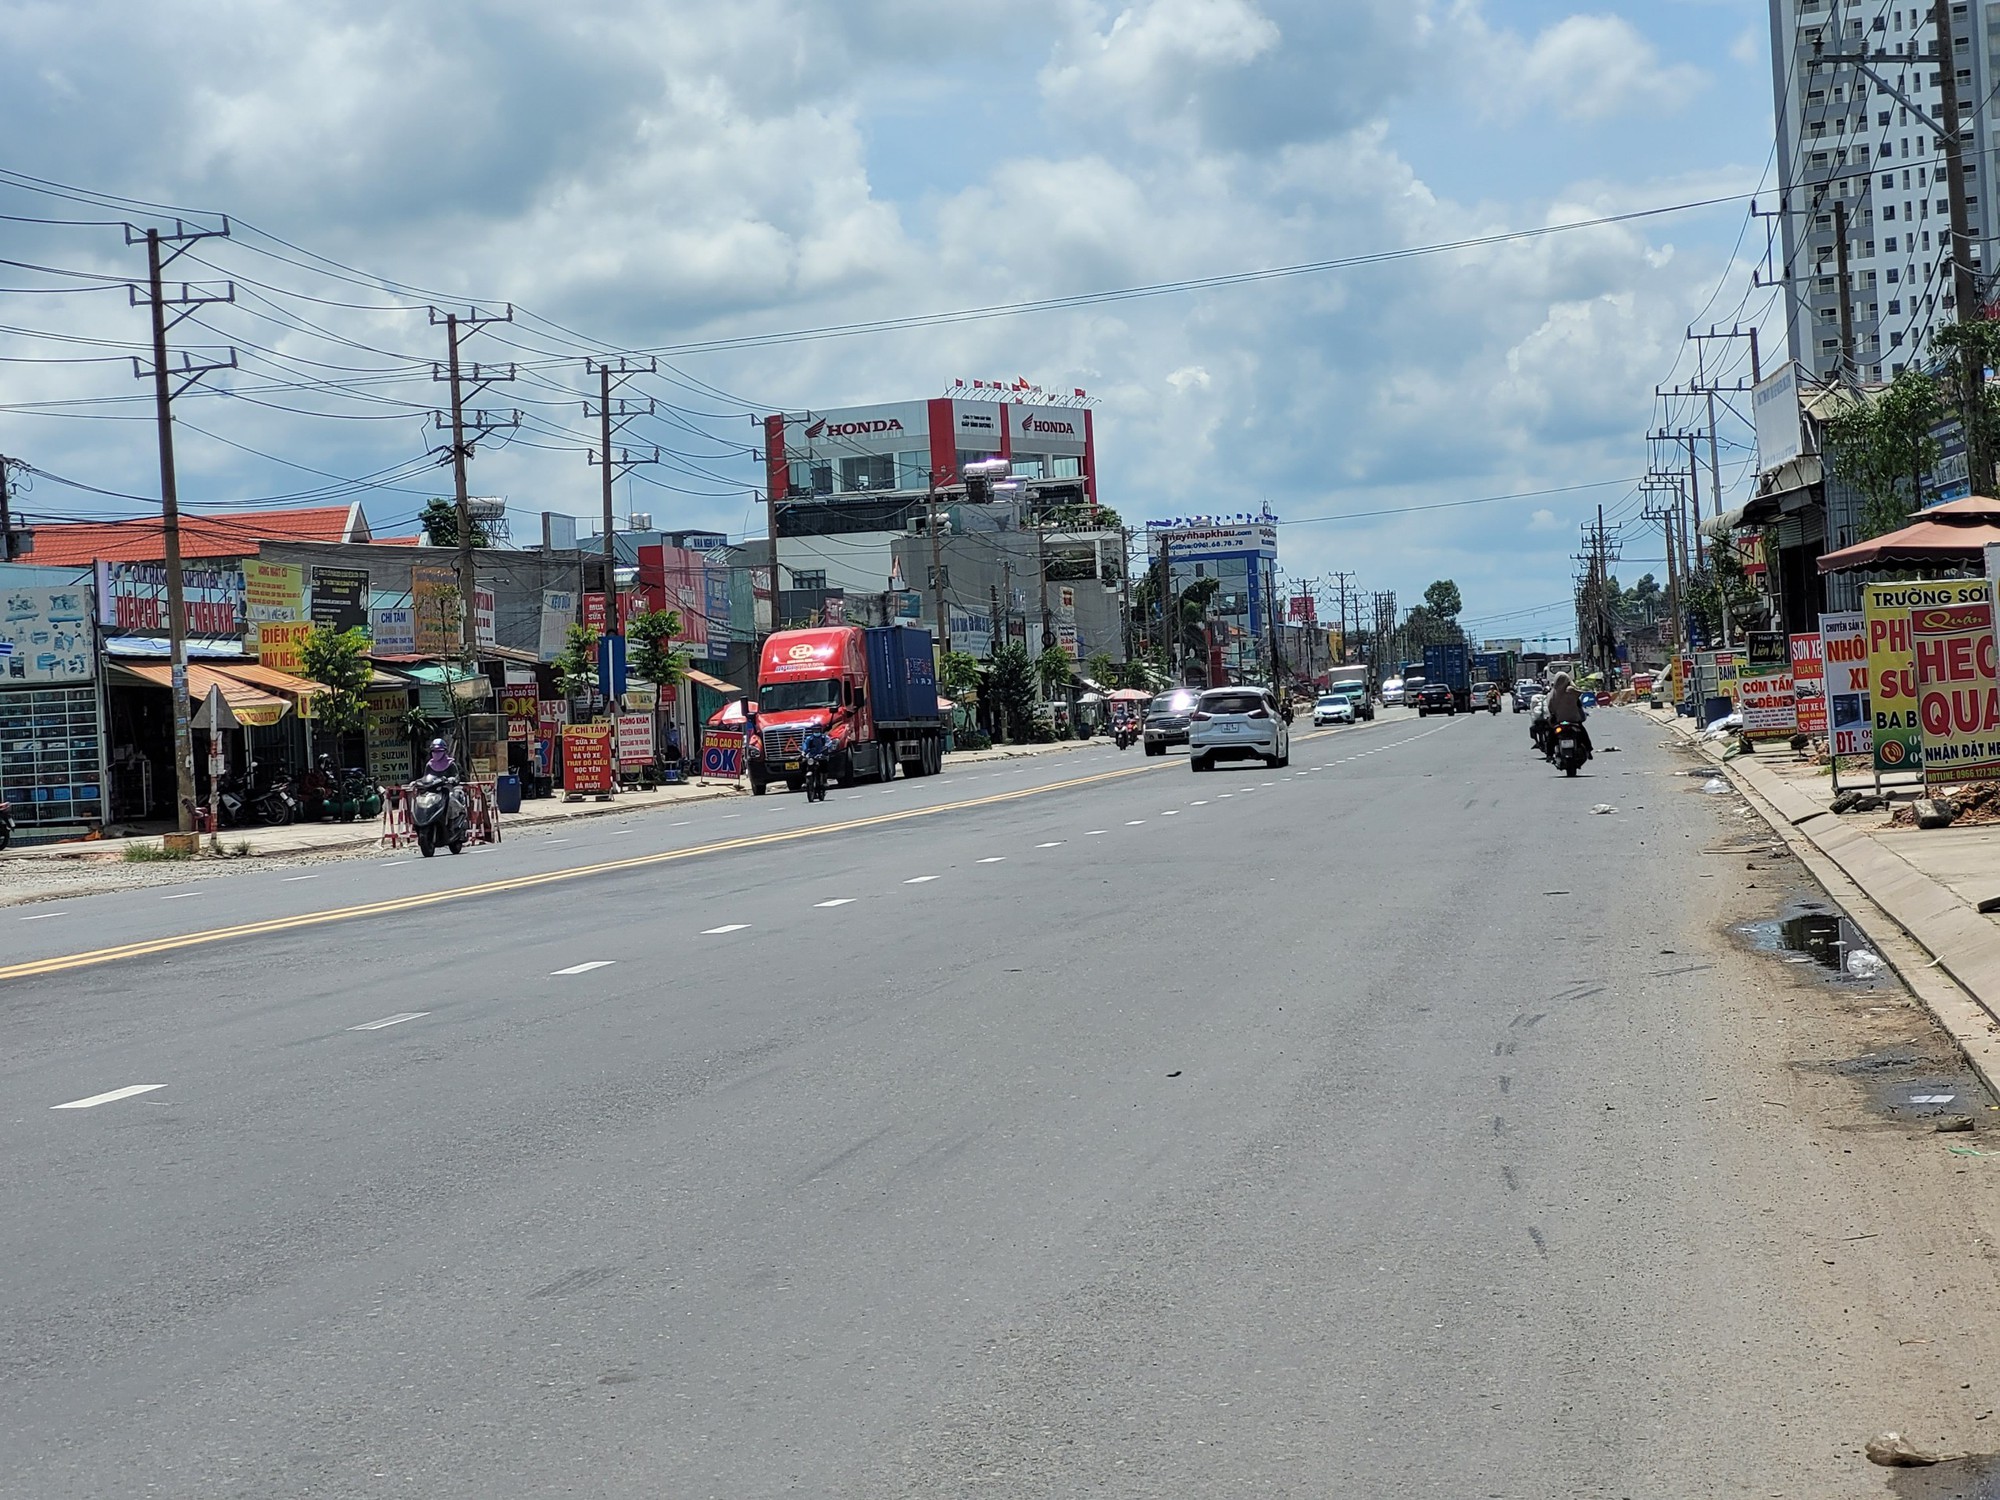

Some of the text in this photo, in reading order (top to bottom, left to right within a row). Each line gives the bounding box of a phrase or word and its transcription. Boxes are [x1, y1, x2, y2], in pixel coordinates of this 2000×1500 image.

[827, 418, 903, 437] HONDA
[1033, 420, 1074, 434] HONDA
[1872, 588, 1952, 606] TRƯỜNG
[1922, 612, 1983, 630] Quán
[262, 625, 289, 647] ĐIỆN
[1792, 638, 1809, 660] SƠN
[1743, 680, 1768, 694] CƠM
[502, 697, 536, 716] OK
[1758, 694, 1783, 708] ĐÊM
[705, 737, 742, 748] BAO CAO SU
[1836, 731, 1857, 752] ĐT:
[381, 750, 408, 760] SUZUKI
[705, 747, 738, 772] OK
[1925, 743, 1959, 764] NHẬN
[1962, 740, 1985, 761] ĐẶT
[383, 763, 409, 772] SYM
